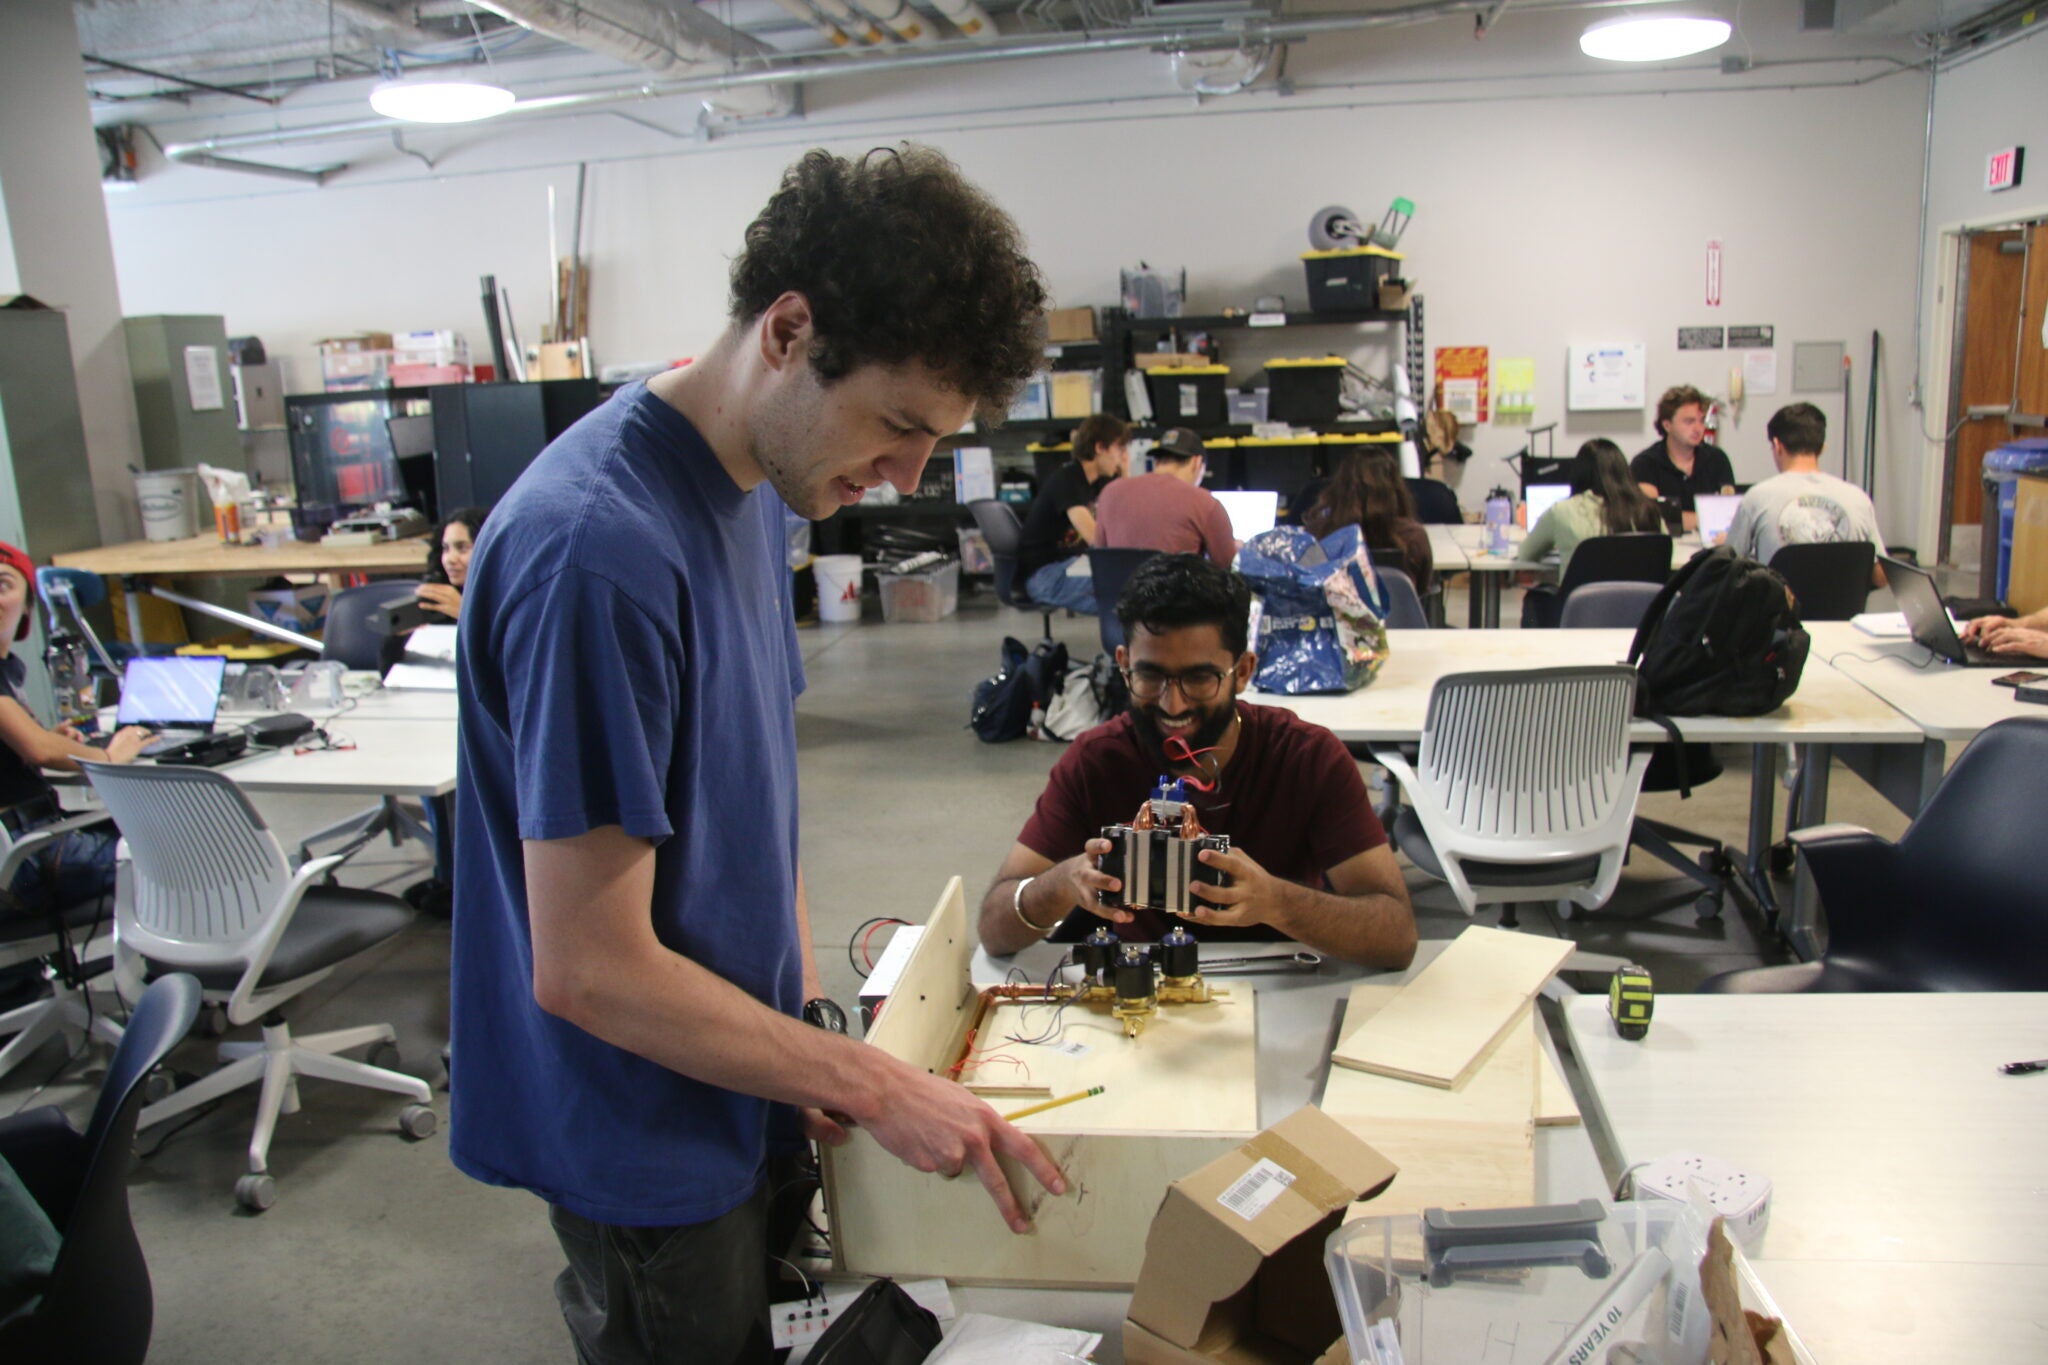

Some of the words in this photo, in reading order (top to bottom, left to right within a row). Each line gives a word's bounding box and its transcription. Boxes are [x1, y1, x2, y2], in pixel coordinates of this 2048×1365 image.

[1989, 152, 2012, 187] EXIT
[1607, 1305, 1622, 1324] 10
[1569, 1322, 1610, 1365] YEARS
